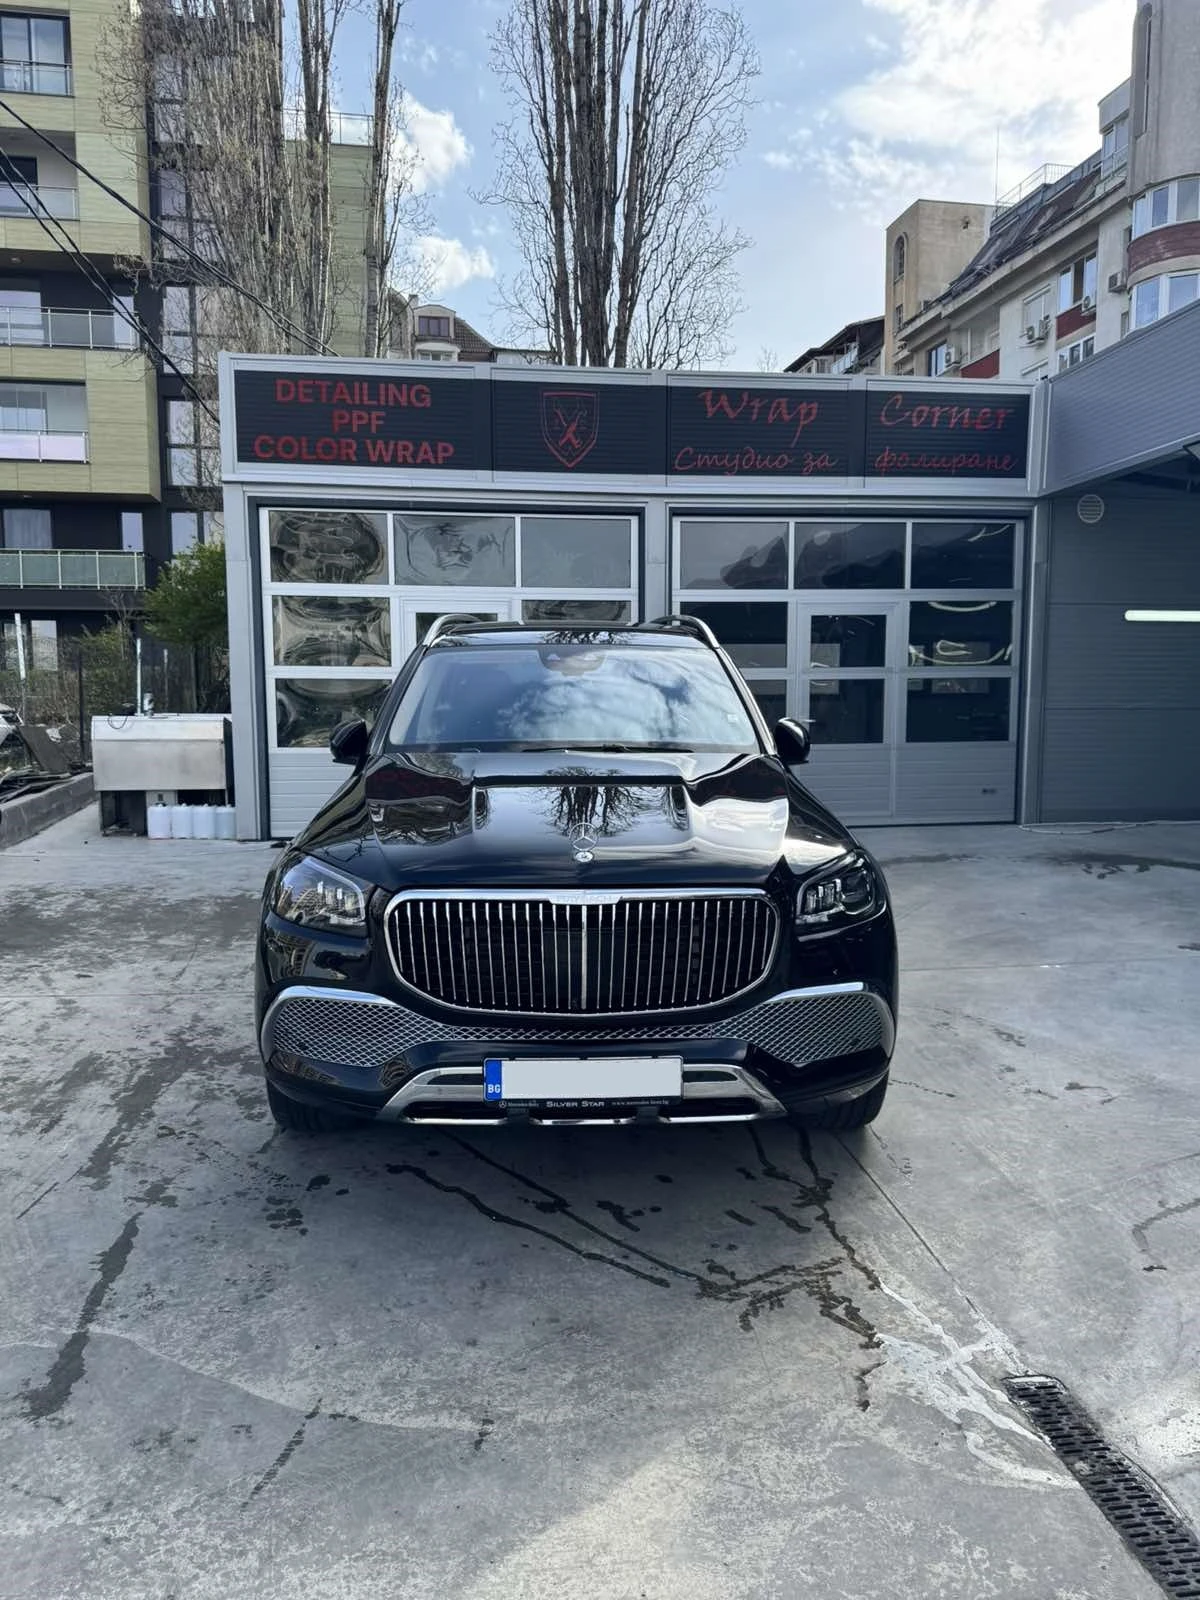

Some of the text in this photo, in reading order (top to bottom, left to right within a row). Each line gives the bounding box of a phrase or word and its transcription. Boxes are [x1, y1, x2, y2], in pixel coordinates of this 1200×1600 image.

[275, 378, 432, 408] DETAILING
[332, 409, 386, 434] PPF
[698, 388, 1013, 448] Wrap Corner
[253, 435, 455, 466] COLOR WRAP
[674, 446, 1016, 477] Студио за фолиране
[487, 1084, 501, 1093] BG
[546, 1100, 578, 1108] SILVER
[581, 1100, 605, 1108] STAR
